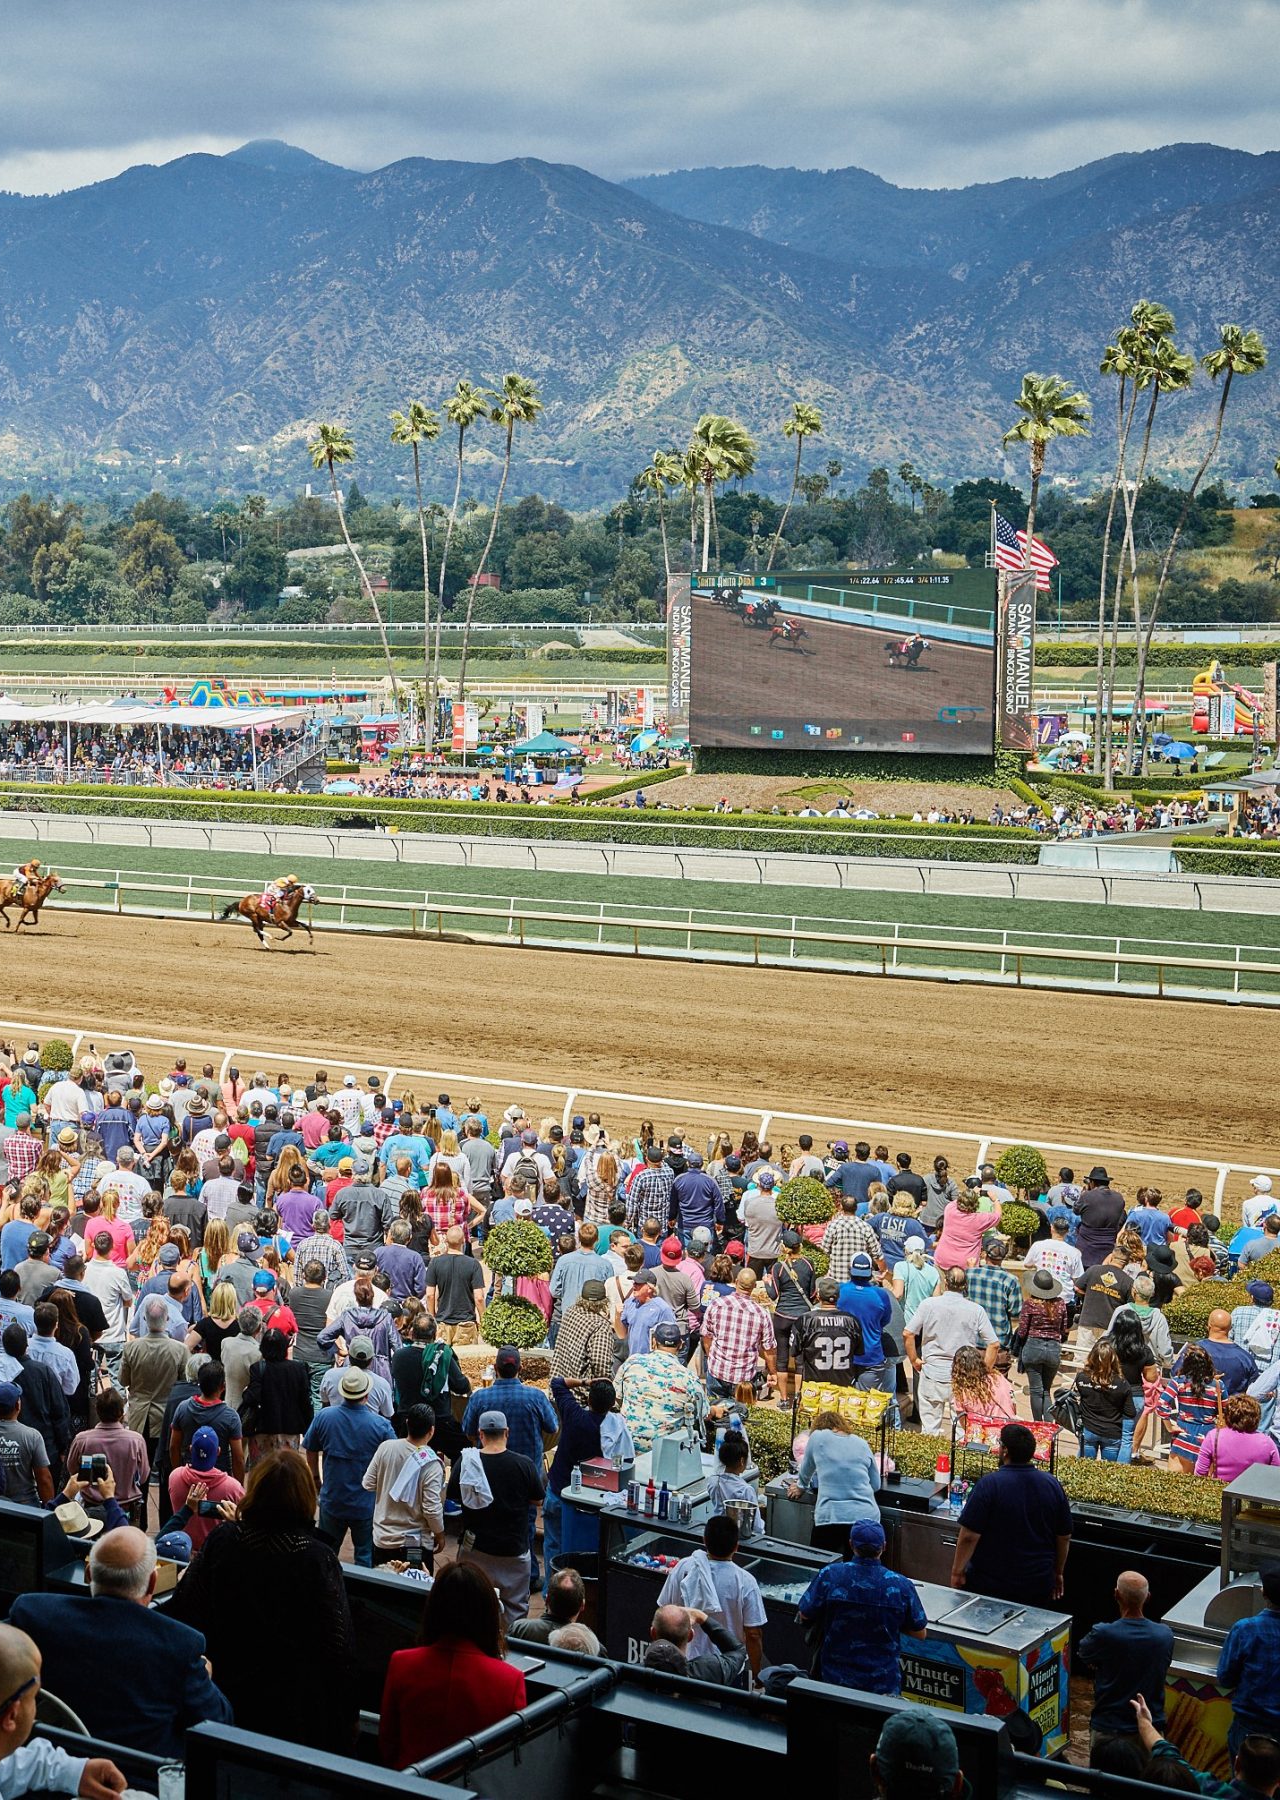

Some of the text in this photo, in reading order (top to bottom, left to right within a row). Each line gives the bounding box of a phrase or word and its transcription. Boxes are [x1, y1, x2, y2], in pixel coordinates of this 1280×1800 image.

[760, 577, 767, 586] 3
[672, 606, 680, 635] INDIAN
[1007, 603, 1017, 635] INDIAN
[672, 648, 680, 672] BINGO
[680, 605, 691, 707] SAN MANUEL
[1006, 649, 1015, 676] BINGO
[1015, 603, 1032, 714] SAN MANUEL
[671, 679, 679, 708] CASINO
[1005, 682, 1015, 714] CASINO
[881, 1216, 907, 1233] FISH
[819, 1316, 845, 1327] TATUM
[814, 1336, 851, 1370] 32
[898, 1658, 960, 1685] Minute
[1030, 1664, 1058, 1690] Minute
[906, 1674, 953, 1698] Maid
[1034, 1677, 1054, 1703] Maid
[918, 1697, 937, 1707] SOFT
